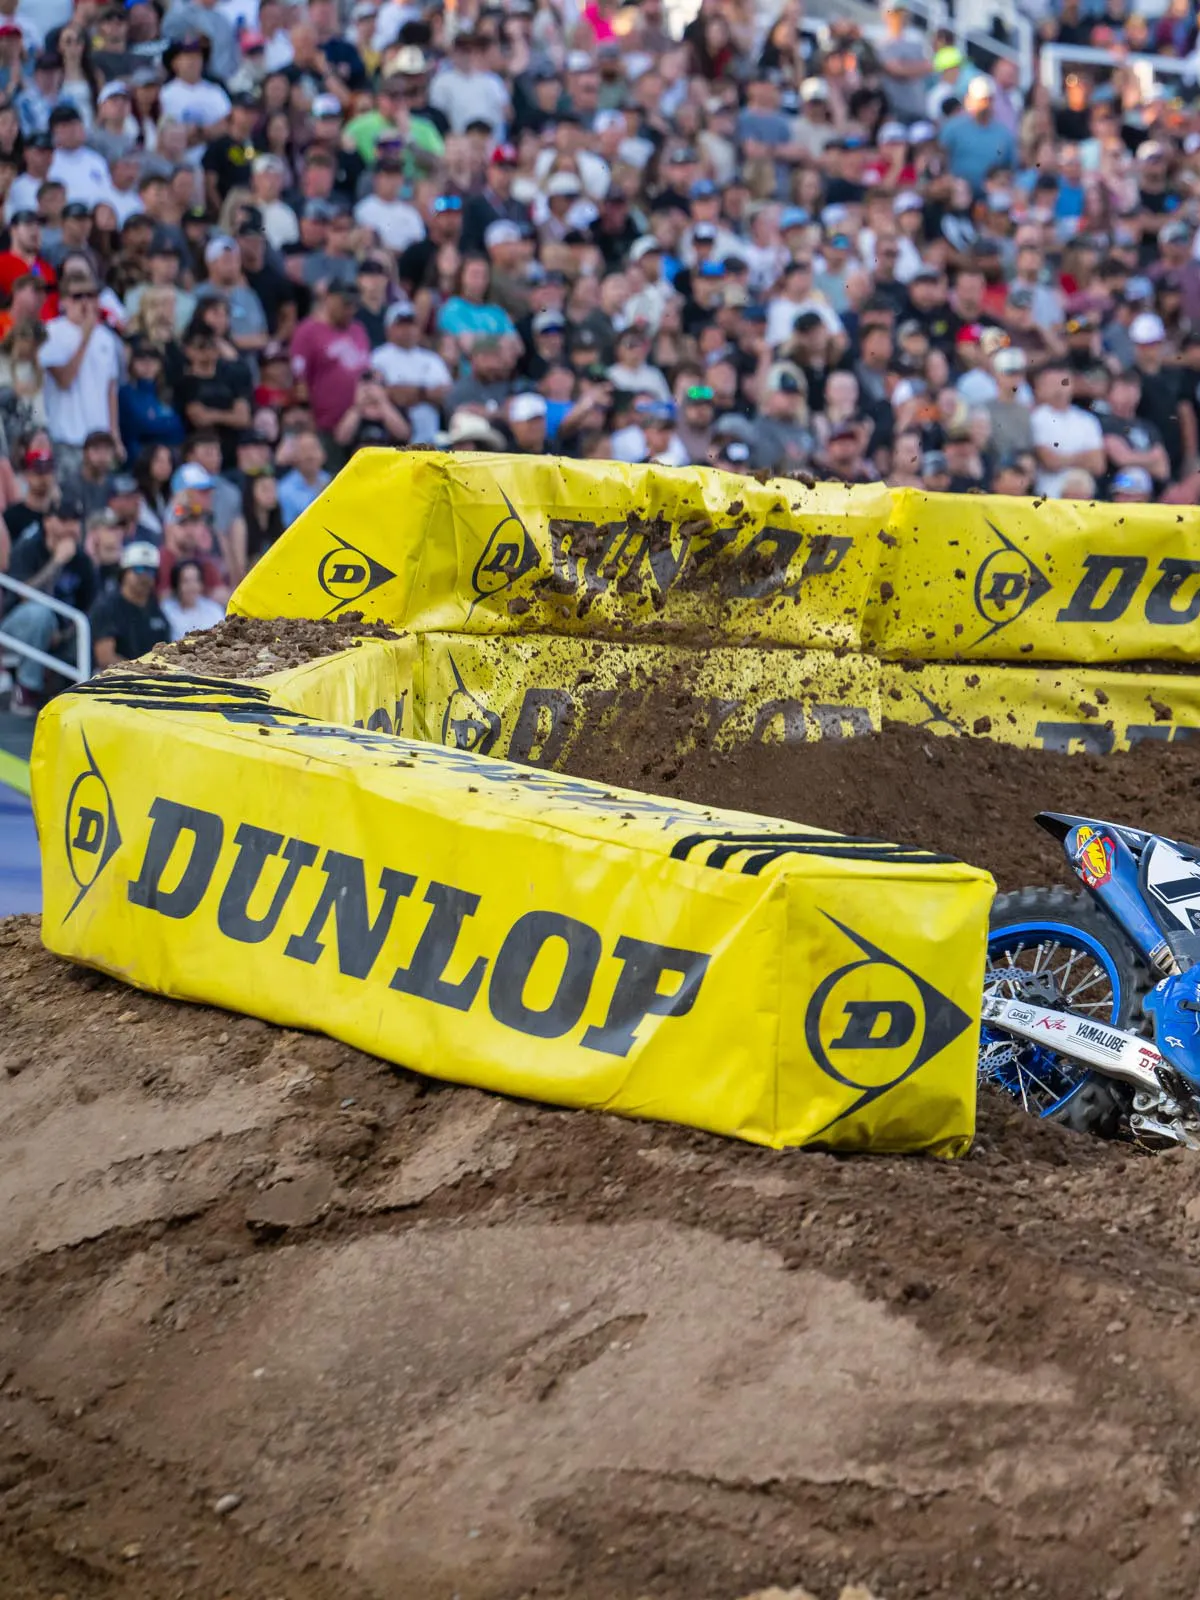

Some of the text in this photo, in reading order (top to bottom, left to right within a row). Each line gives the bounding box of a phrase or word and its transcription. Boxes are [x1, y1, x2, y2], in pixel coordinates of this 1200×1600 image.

[329, 563, 367, 584] D
[983, 572, 1027, 601] D
[74, 796, 712, 1058] D DUNLOP
[829, 1000, 916, 1049] D
[1075, 1022, 1127, 1053] YAMALUBE
